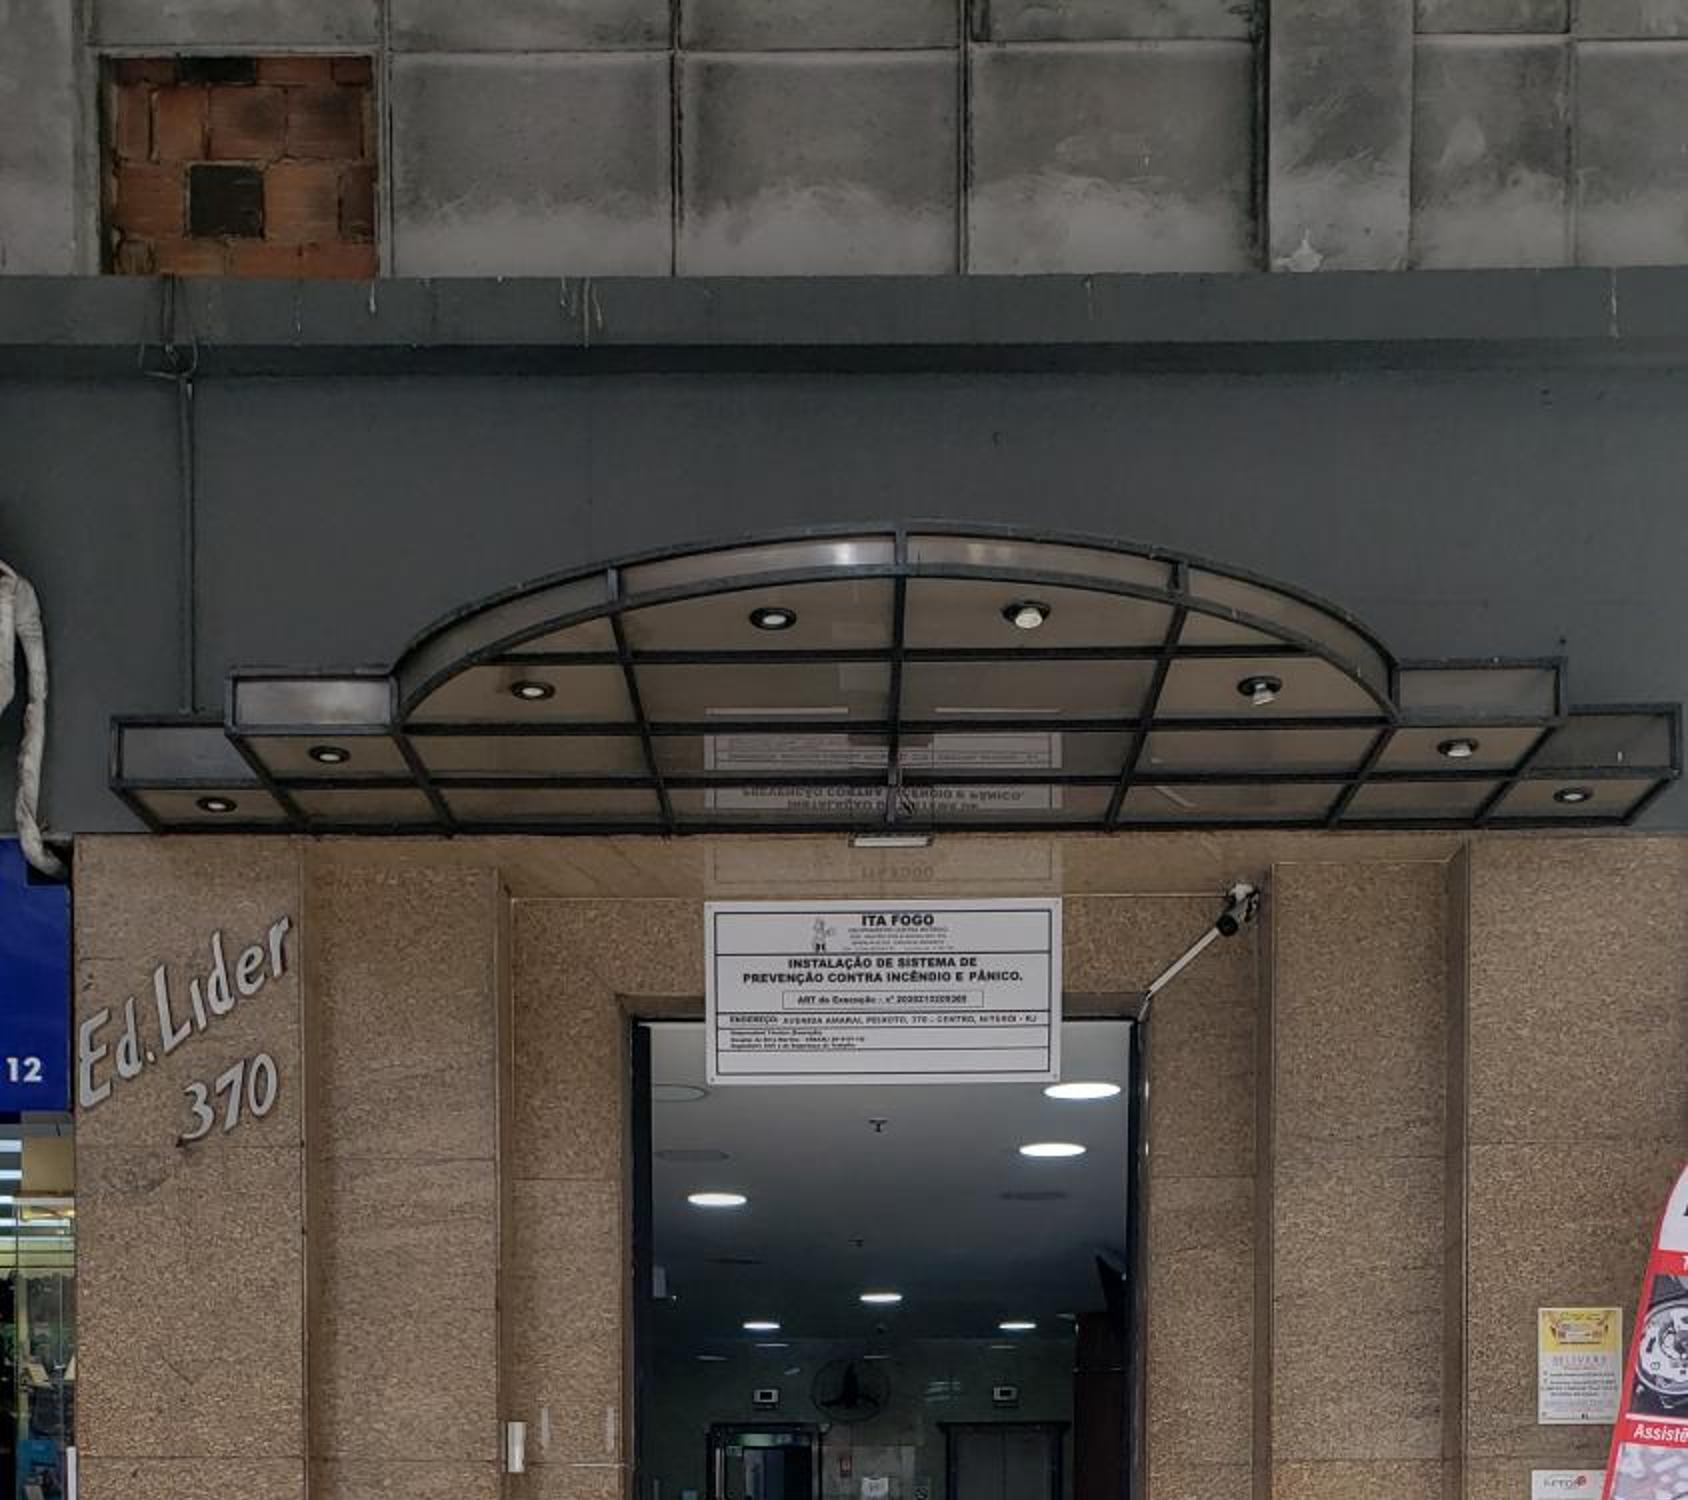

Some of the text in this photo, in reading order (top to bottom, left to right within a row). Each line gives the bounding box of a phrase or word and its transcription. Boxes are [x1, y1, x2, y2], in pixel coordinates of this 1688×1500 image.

[861, 914, 934, 926] ITA FOGO
[788, 957, 977, 969] INSTALAÇÃO DE SISTEMA DE
[743, 969, 1023, 985] PREVENÇÃO CONTRA INCÊNDIO E PÂNICO.
[7, 1056, 43, 1083] 12
[178, 1053, 278, 1146] 370
